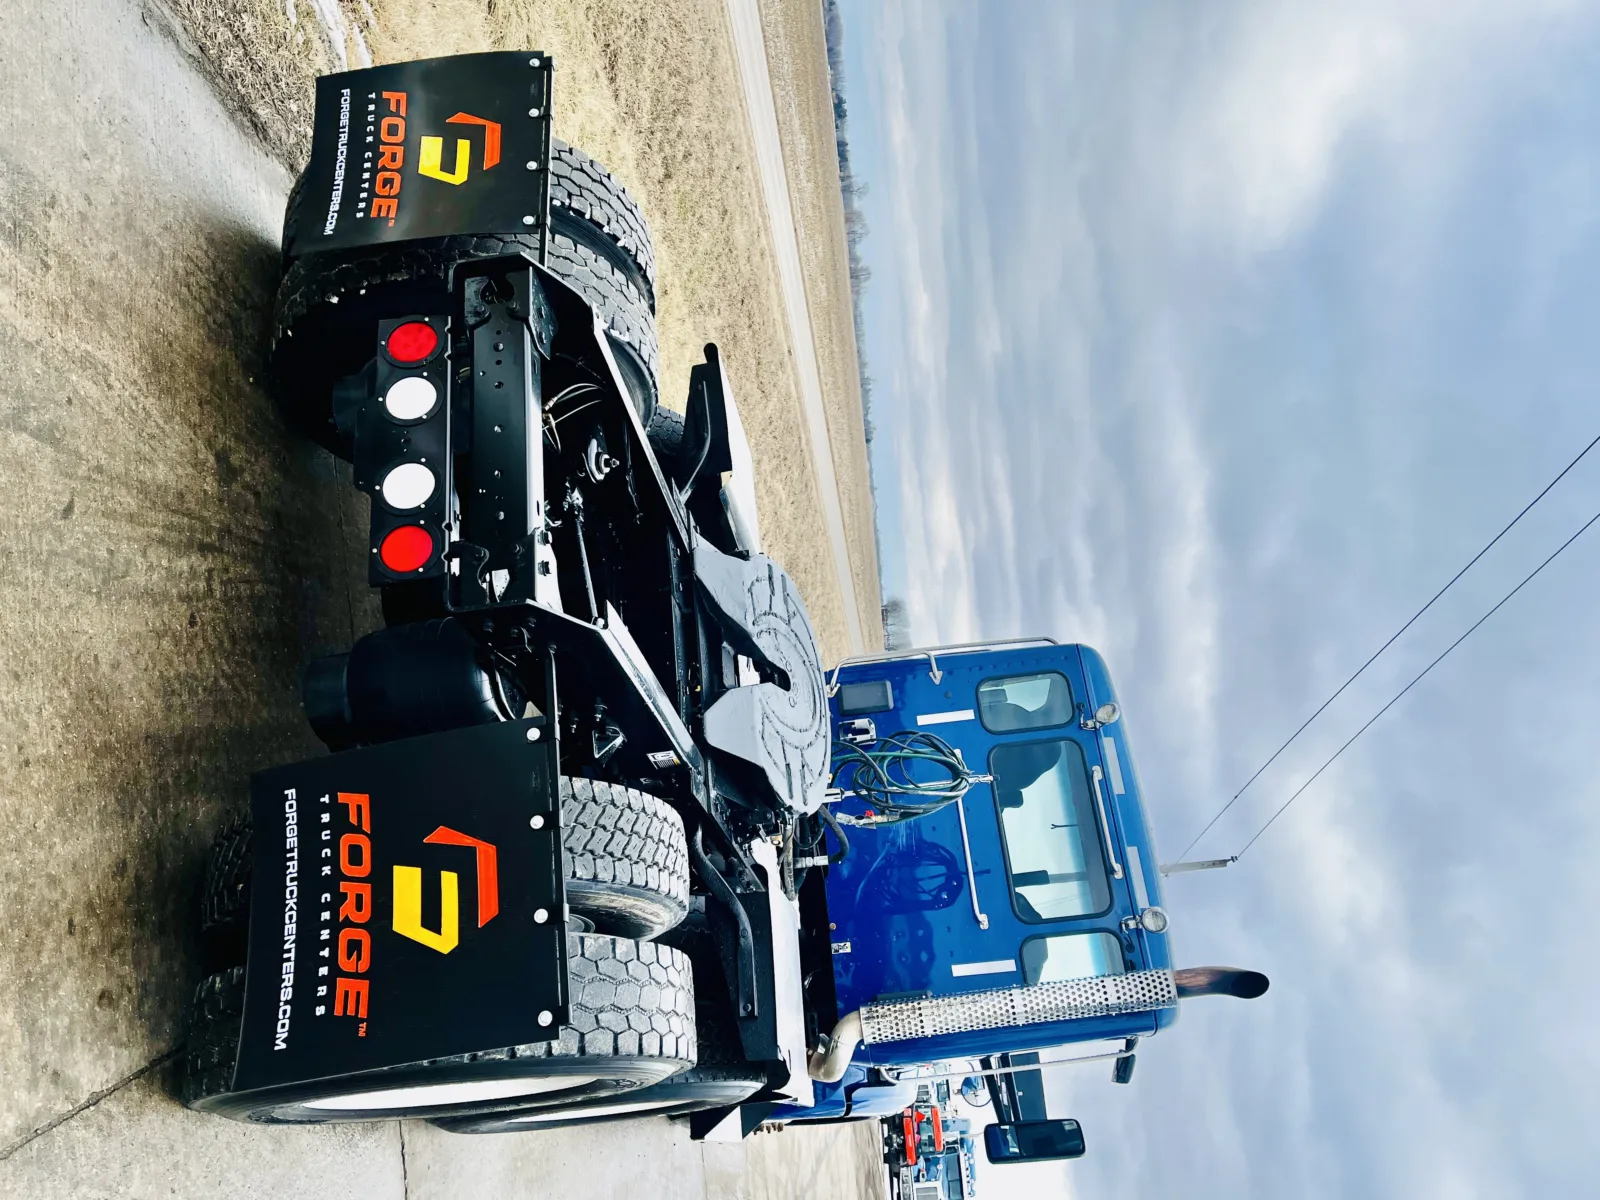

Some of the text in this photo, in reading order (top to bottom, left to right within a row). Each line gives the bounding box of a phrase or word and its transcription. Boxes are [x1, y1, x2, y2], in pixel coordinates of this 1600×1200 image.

[323, 88, 351, 235] FORGETRUCKCENTERS.COM
[356, 92, 376, 218] TRUCK CENTERS
[370, 91, 407, 218] FORGE
[273, 788, 298, 1050] FORGETRUCKCENTERS.COM
[315, 793, 332, 1016] TRUCK CENTERS
[333, 792, 371, 1018] FORGE
